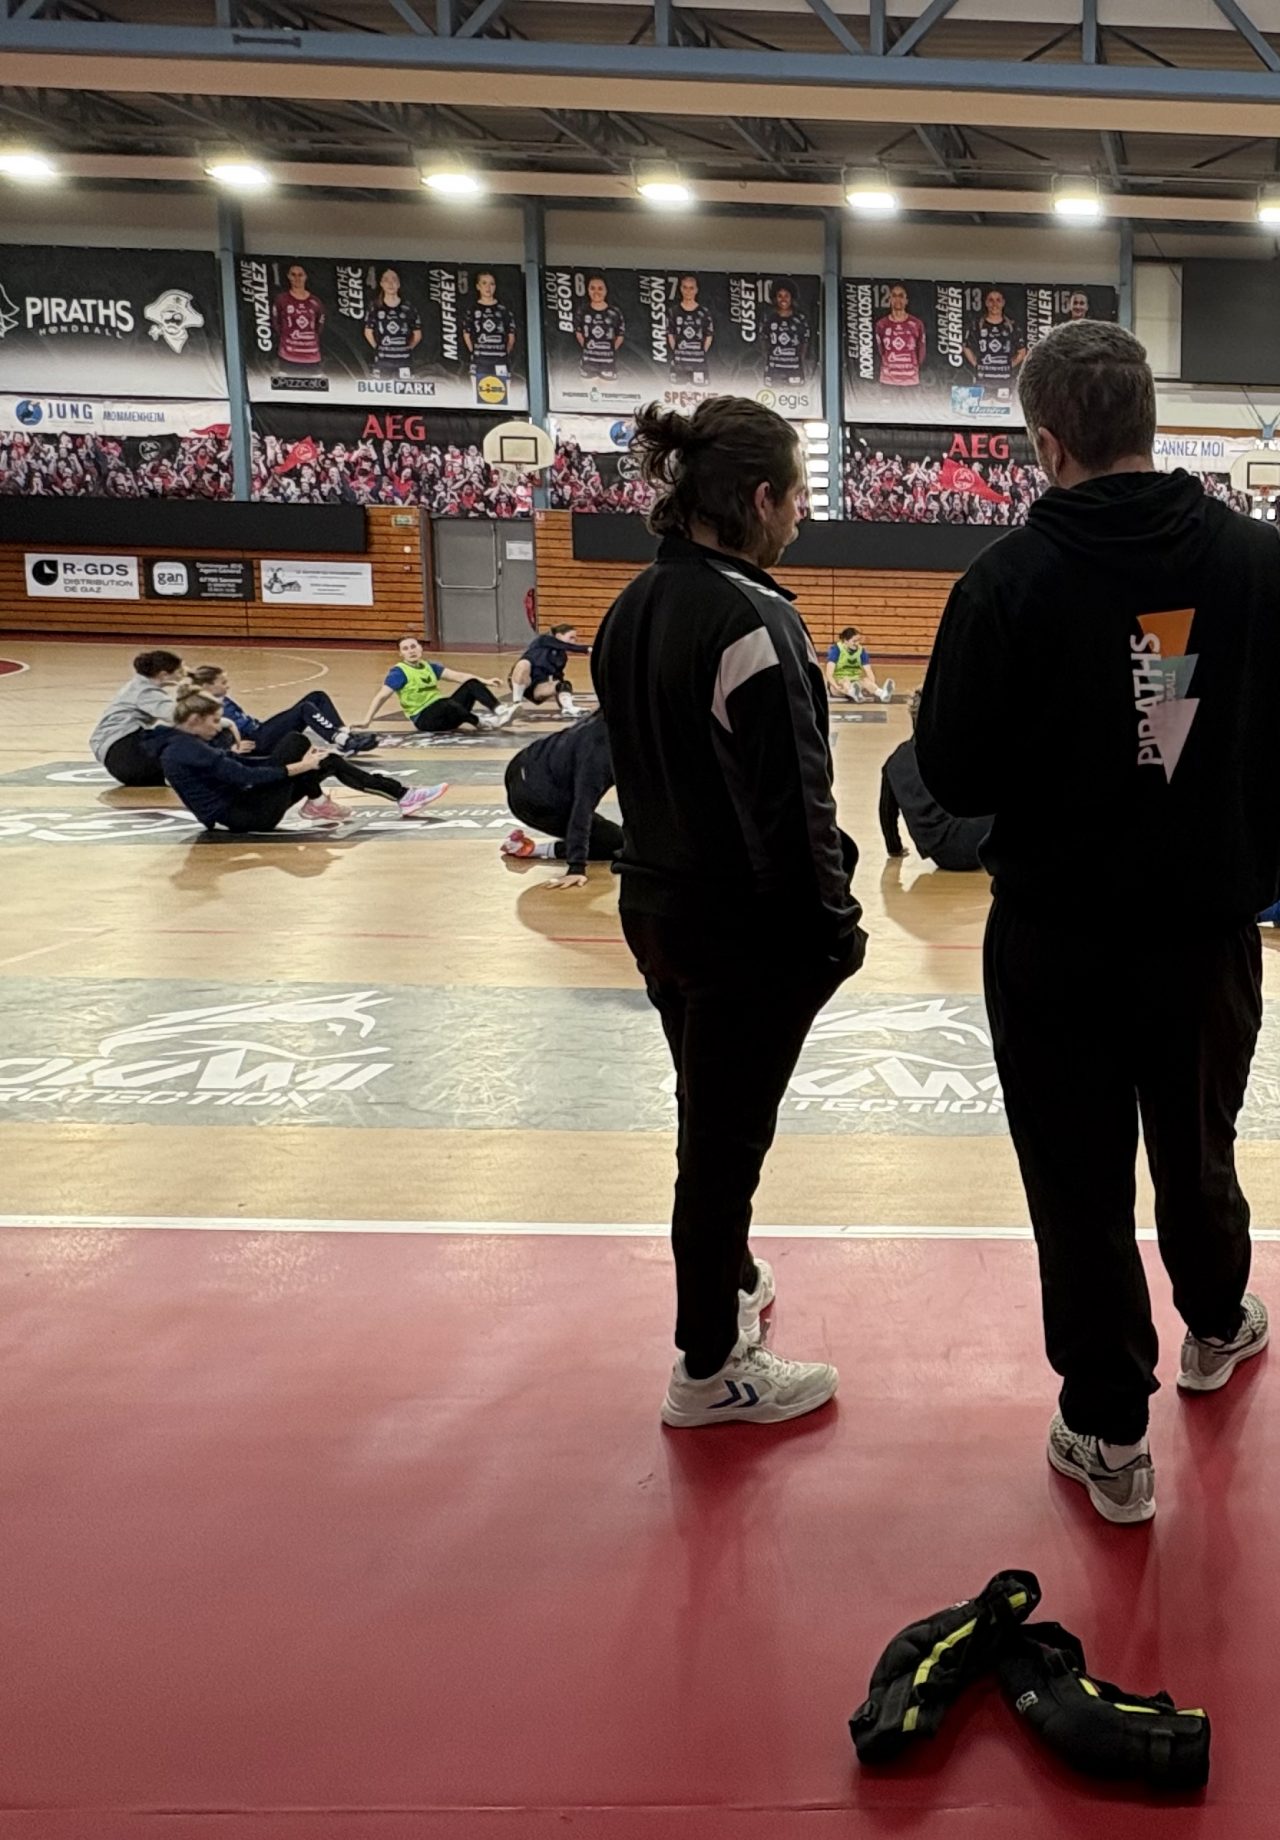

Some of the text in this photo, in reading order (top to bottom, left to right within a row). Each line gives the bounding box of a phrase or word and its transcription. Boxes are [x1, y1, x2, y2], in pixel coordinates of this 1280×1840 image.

[336, 265, 350, 317] AGATHE
[348, 266, 365, 320] CLERC
[429, 268, 443, 303] JULIA
[545, 271, 558, 311] LILOU
[556, 272, 575, 333] BEGON
[639, 275, 651, 305] ELIN
[668, 277, 678, 300] 7
[730, 279, 741, 323] LOUISE
[964, 287, 983, 312] 13
[25, 296, 135, 332] PIRATHS
[251, 261, 273, 352] GONZALEZ
[440, 268, 459, 361] MAUFFREY
[651, 276, 667, 363] KARLSSON
[741, 279, 756, 342] CUSSET
[846, 283, 858, 360] ELIHANNAH
[937, 285, 950, 355] CHARLÈNE
[1026, 289, 1038, 348] ORENTINE
[949, 287, 963, 368] GUERRIER
[47, 402, 94, 420] JUNG
[778, 393, 809, 409] egis
[363, 414, 426, 441] AEG
[950, 433, 1010, 460] AEG
[1154, 440, 1225, 457] CANNEZ MOI
[63, 562, 129, 577] R-GDS
[63, 578, 133, 588] DISTRIBUTION
[157, 572, 184, 586] gan
[80, 586, 101, 594] GAZ
[1130, 632, 1164, 766] PIRATHS
[0, 1087, 326, 1107] ROTECTION
[789, 1097, 1005, 1114] TECTION
